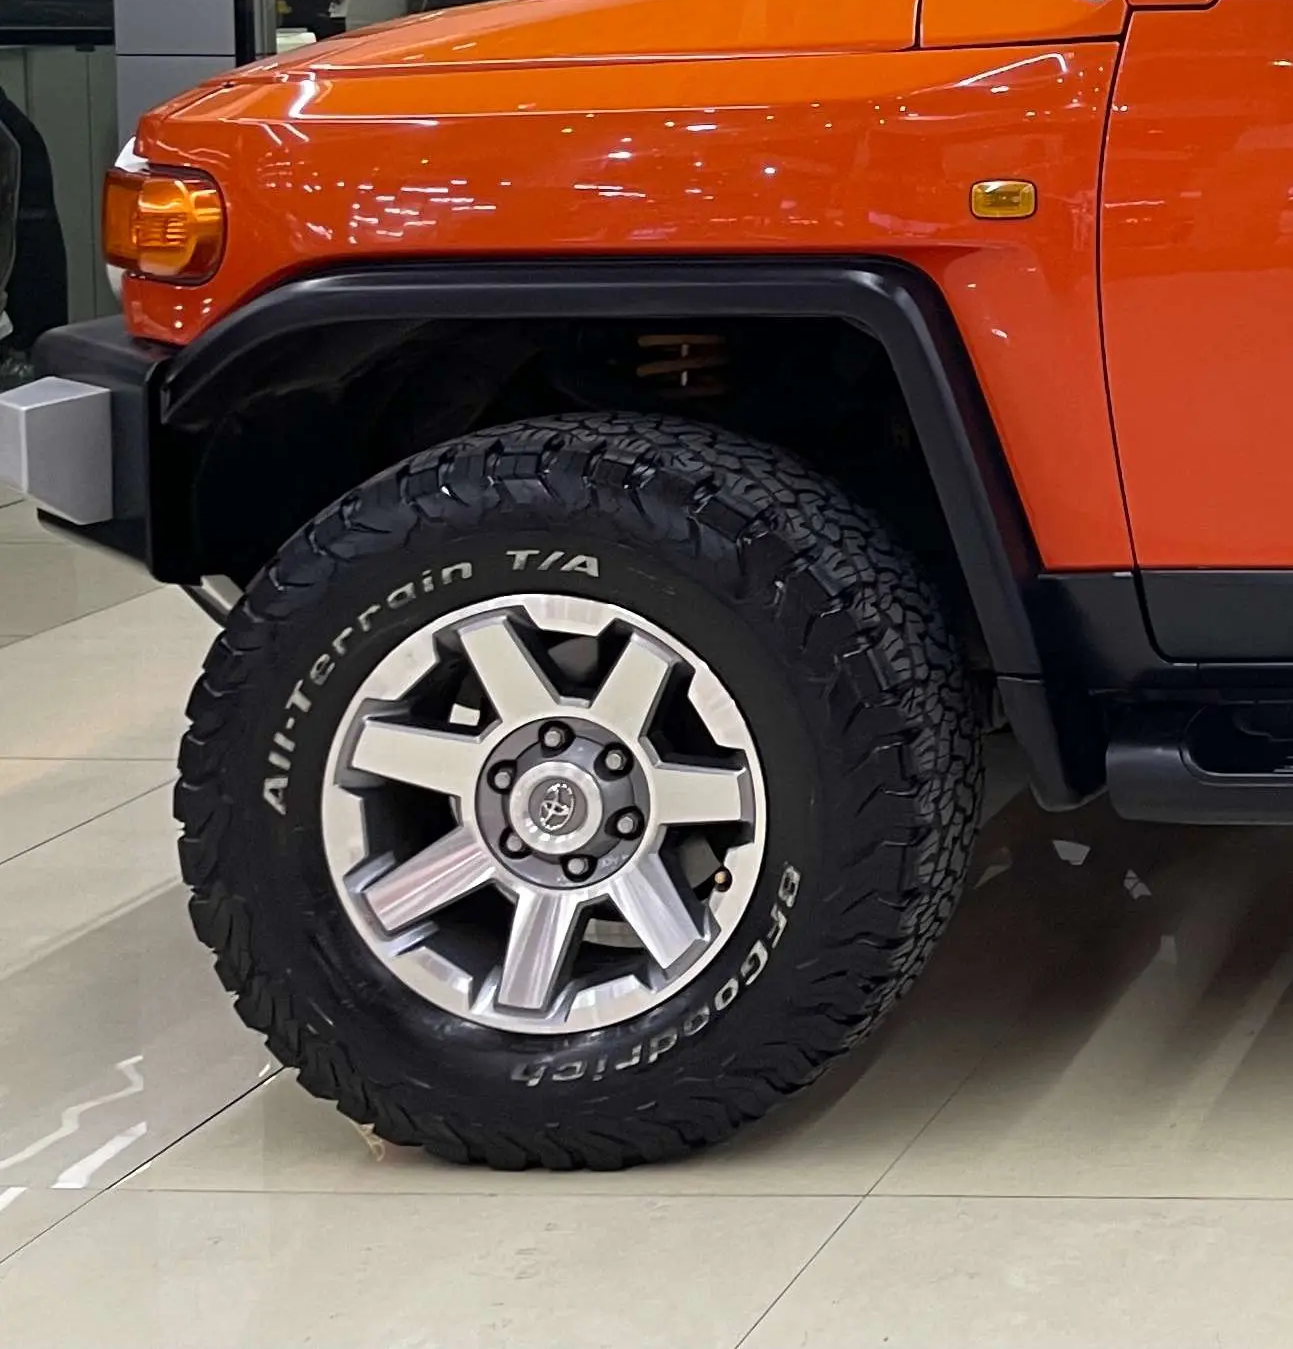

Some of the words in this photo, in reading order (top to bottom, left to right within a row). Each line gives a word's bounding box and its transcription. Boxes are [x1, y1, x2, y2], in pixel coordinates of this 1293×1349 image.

[262, 560, 473, 815] All-Terrain
[505, 549, 600, 578] T/A
[510, 861, 801, 1087] BFGoodrich
